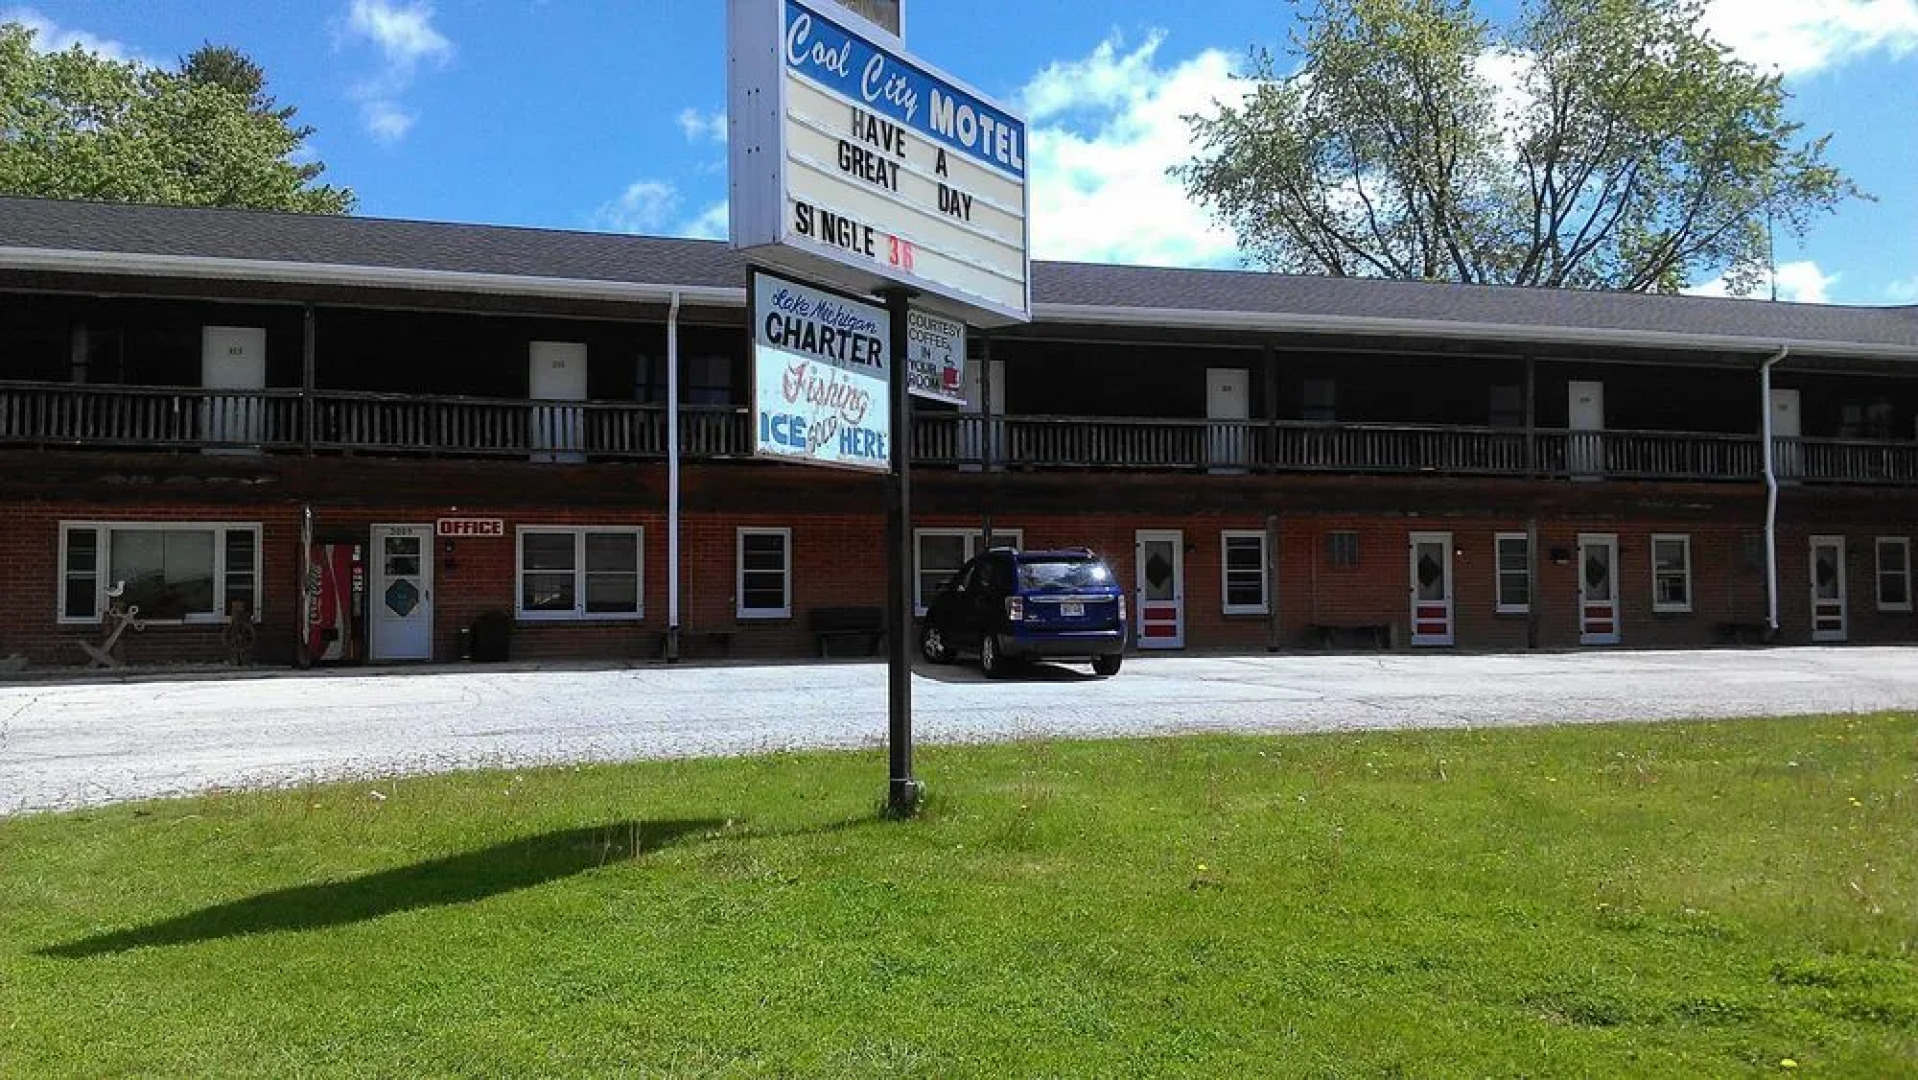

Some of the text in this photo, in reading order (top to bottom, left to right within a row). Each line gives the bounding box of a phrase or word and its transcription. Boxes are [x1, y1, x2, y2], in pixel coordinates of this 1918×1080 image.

[787, 13, 1024, 170] Cool City MOTEL
[852, 106, 948, 178] HAVE A
[837, 139, 973, 222] GREAT DAY
[795, 201, 875, 257] SINGLE
[772, 289, 878, 334] Lake Michigan
[908, 312, 962, 339] COURTESY
[765, 312, 883, 369] CHARTER
[908, 327, 949, 350] COFFEE
[782, 360, 869, 425] Fishing
[907, 359, 937, 376] YOUR
[760, 411, 806, 448] ICE
[840, 426, 887, 459] HERE
[440, 520, 502, 534] OFFICE
